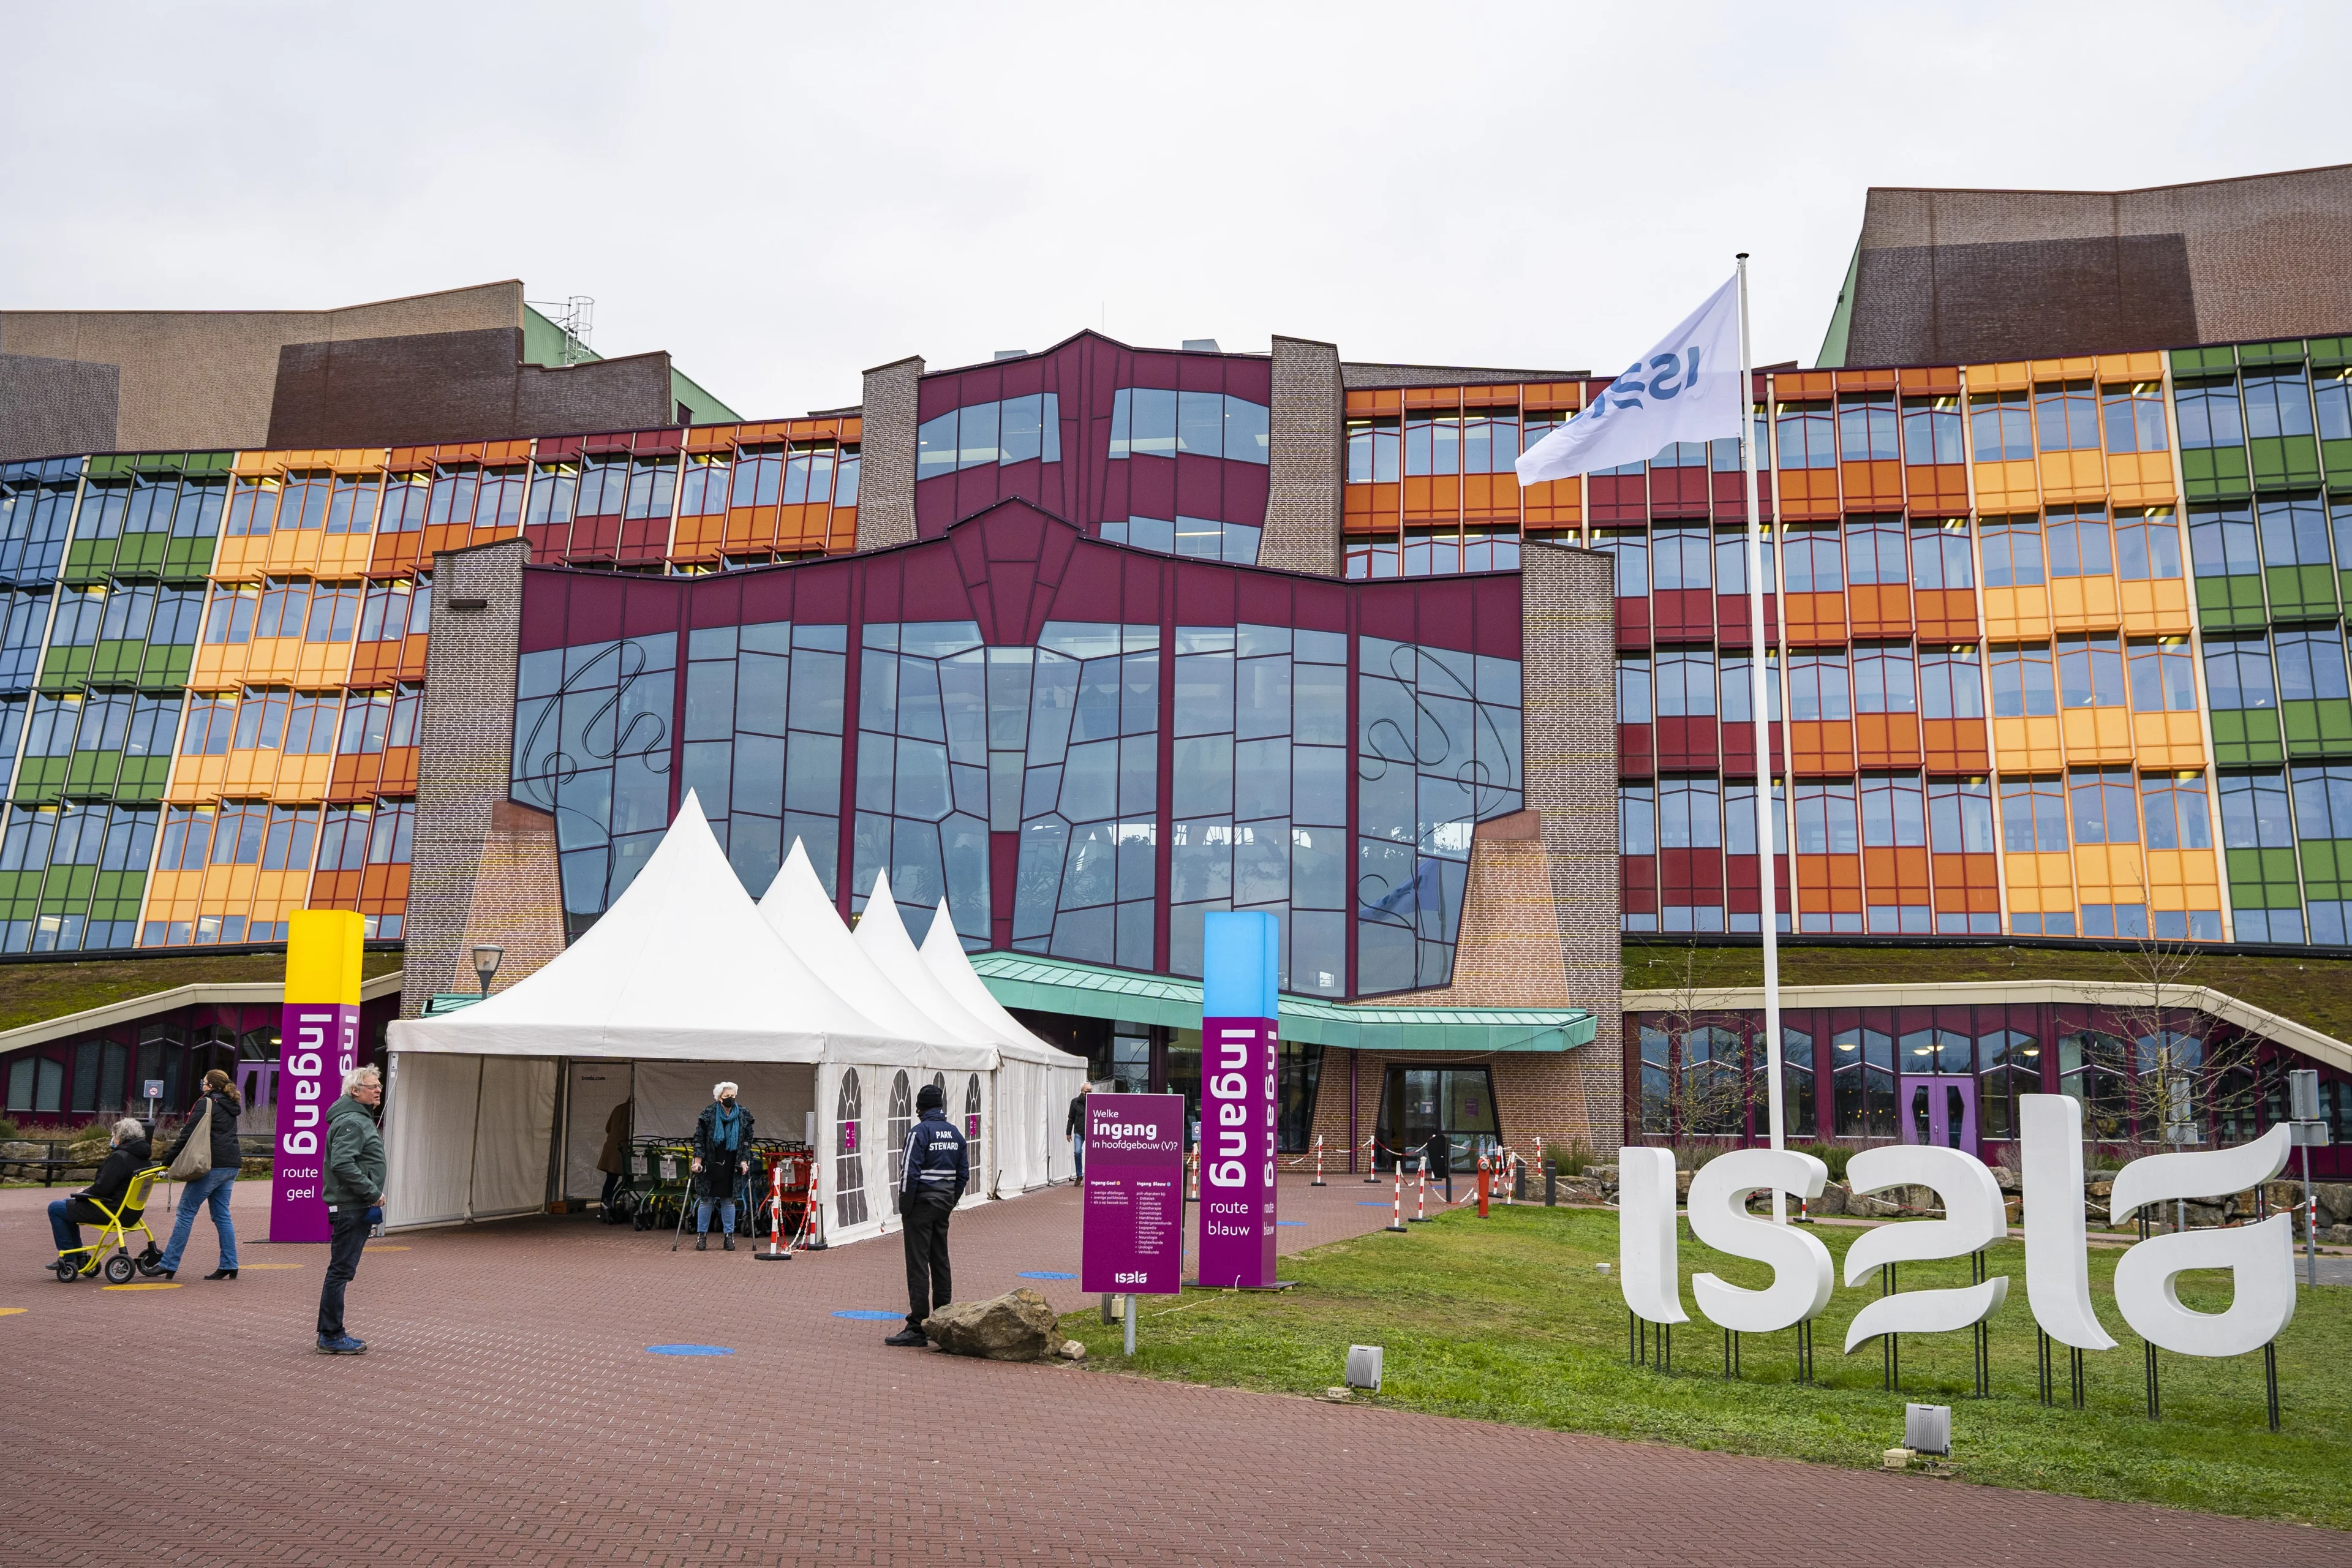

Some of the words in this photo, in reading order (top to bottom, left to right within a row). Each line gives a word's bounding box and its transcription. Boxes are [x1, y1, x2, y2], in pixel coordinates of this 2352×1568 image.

[339, 1015, 357, 1077] Ing
[283, 1014, 332, 1155] Ingang
[1093, 1109, 1119, 1118] Welke
[1208, 1029, 1256, 1188] Ingang
[1264, 1030, 1277, 1188] Ingang
[1093, 1118, 1157, 1140] ingang
[929, 1142, 959, 1151] STEWARD
[1092, 1140, 1100, 1148] in
[1101, 1140, 1160, 1151] hoofdgebouw
[1161, 1140, 1178, 1152] (V)?
[282, 1167, 318, 1178] route
[287, 1185, 314, 1202] geel
[1210, 1201, 1249, 1215] route
[1264, 1201, 1275, 1214] route
[1208, 1221, 1251, 1237] blauw
[1264, 1221, 1275, 1236] blauw
